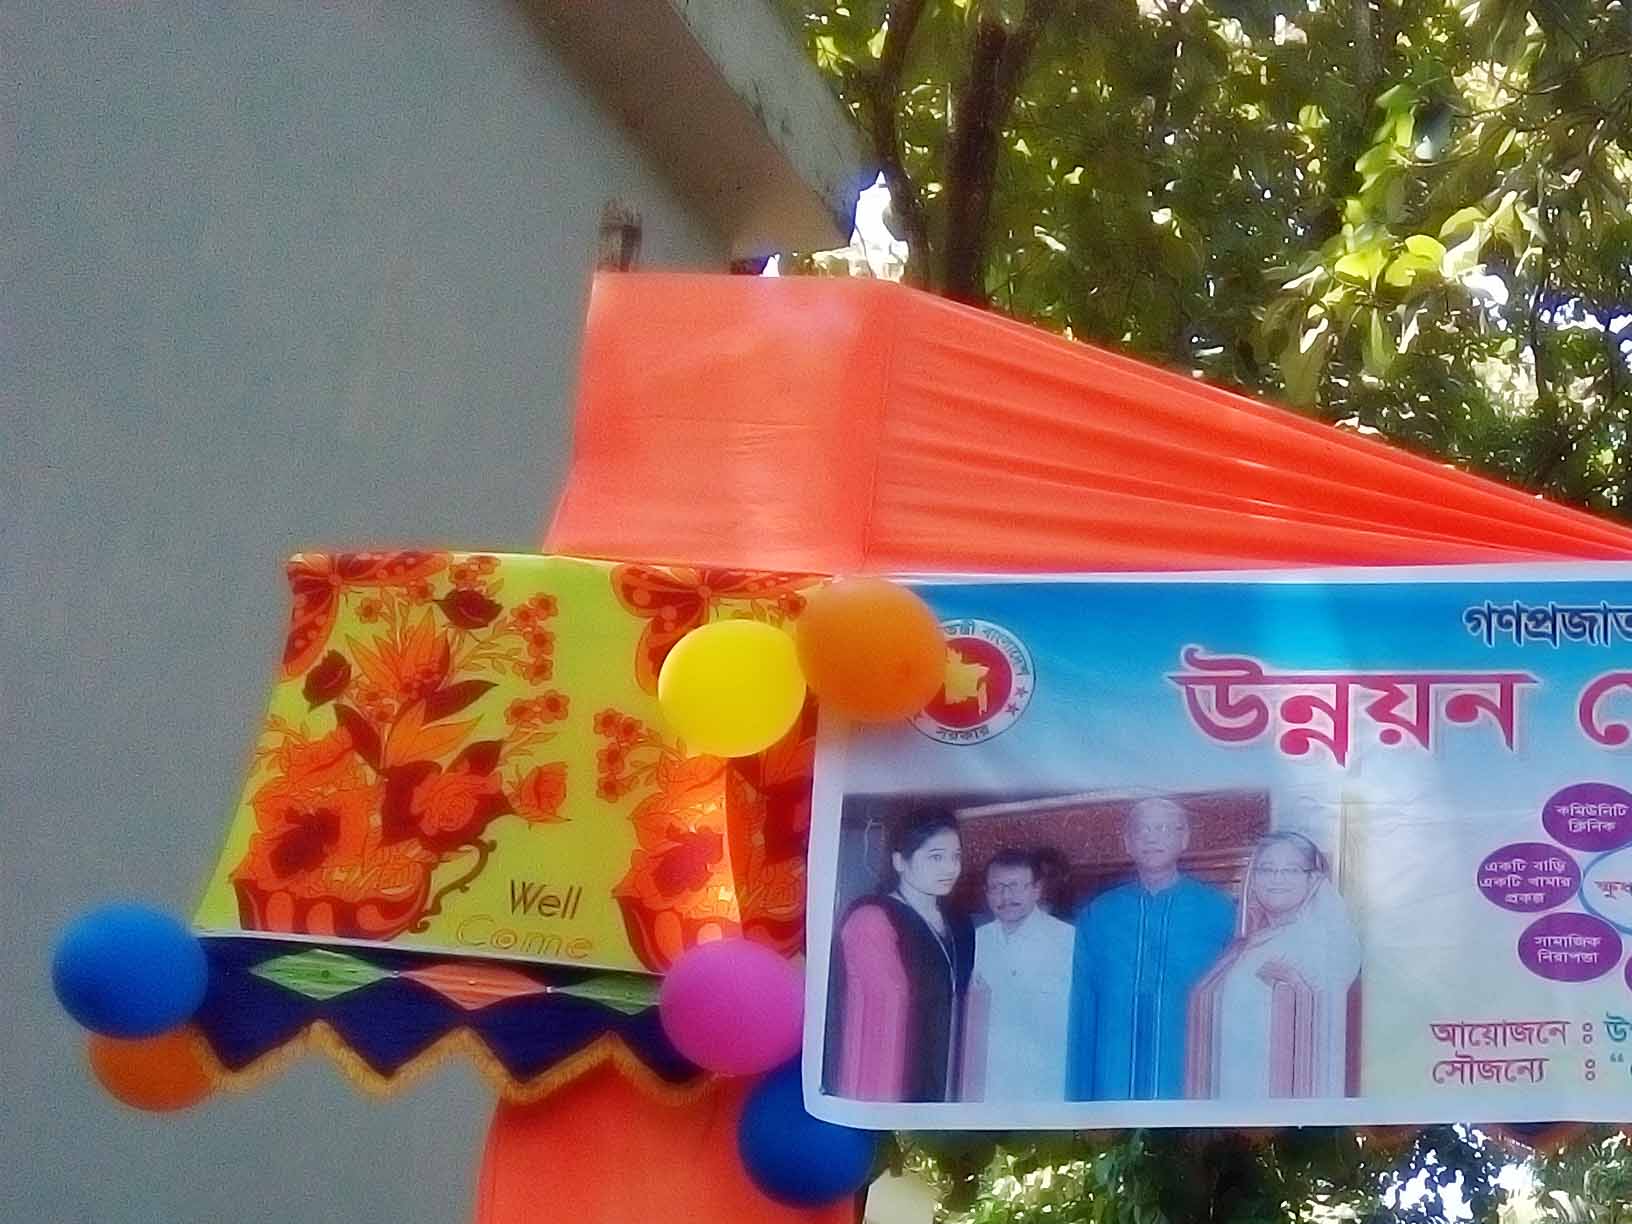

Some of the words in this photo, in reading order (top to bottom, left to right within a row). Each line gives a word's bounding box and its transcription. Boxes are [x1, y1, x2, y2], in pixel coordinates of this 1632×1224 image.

[1164, 644, 1541, 769] উন্নয়ন
[1555, 803, 1630, 817] কমিউনিটি
[1568, 818, 1617, 833] ক্লিনিক
[1484, 858, 1528, 872] একটি
[1532, 857, 1568, 873] বাড়ি
[1479, 875, 1523, 889] একটি
[1527, 875, 1573, 889] খামার
[510, 879, 584, 920] Well
[457, 914, 593, 958] Come
[1534, 932, 1601, 948] সামাজিক
[1536, 948, 1599, 964] নিরাপত্তা
[1430, 1018, 1571, 1049] আয়োজনে
[1432, 1051, 1551, 1086] সৌজন্যে
